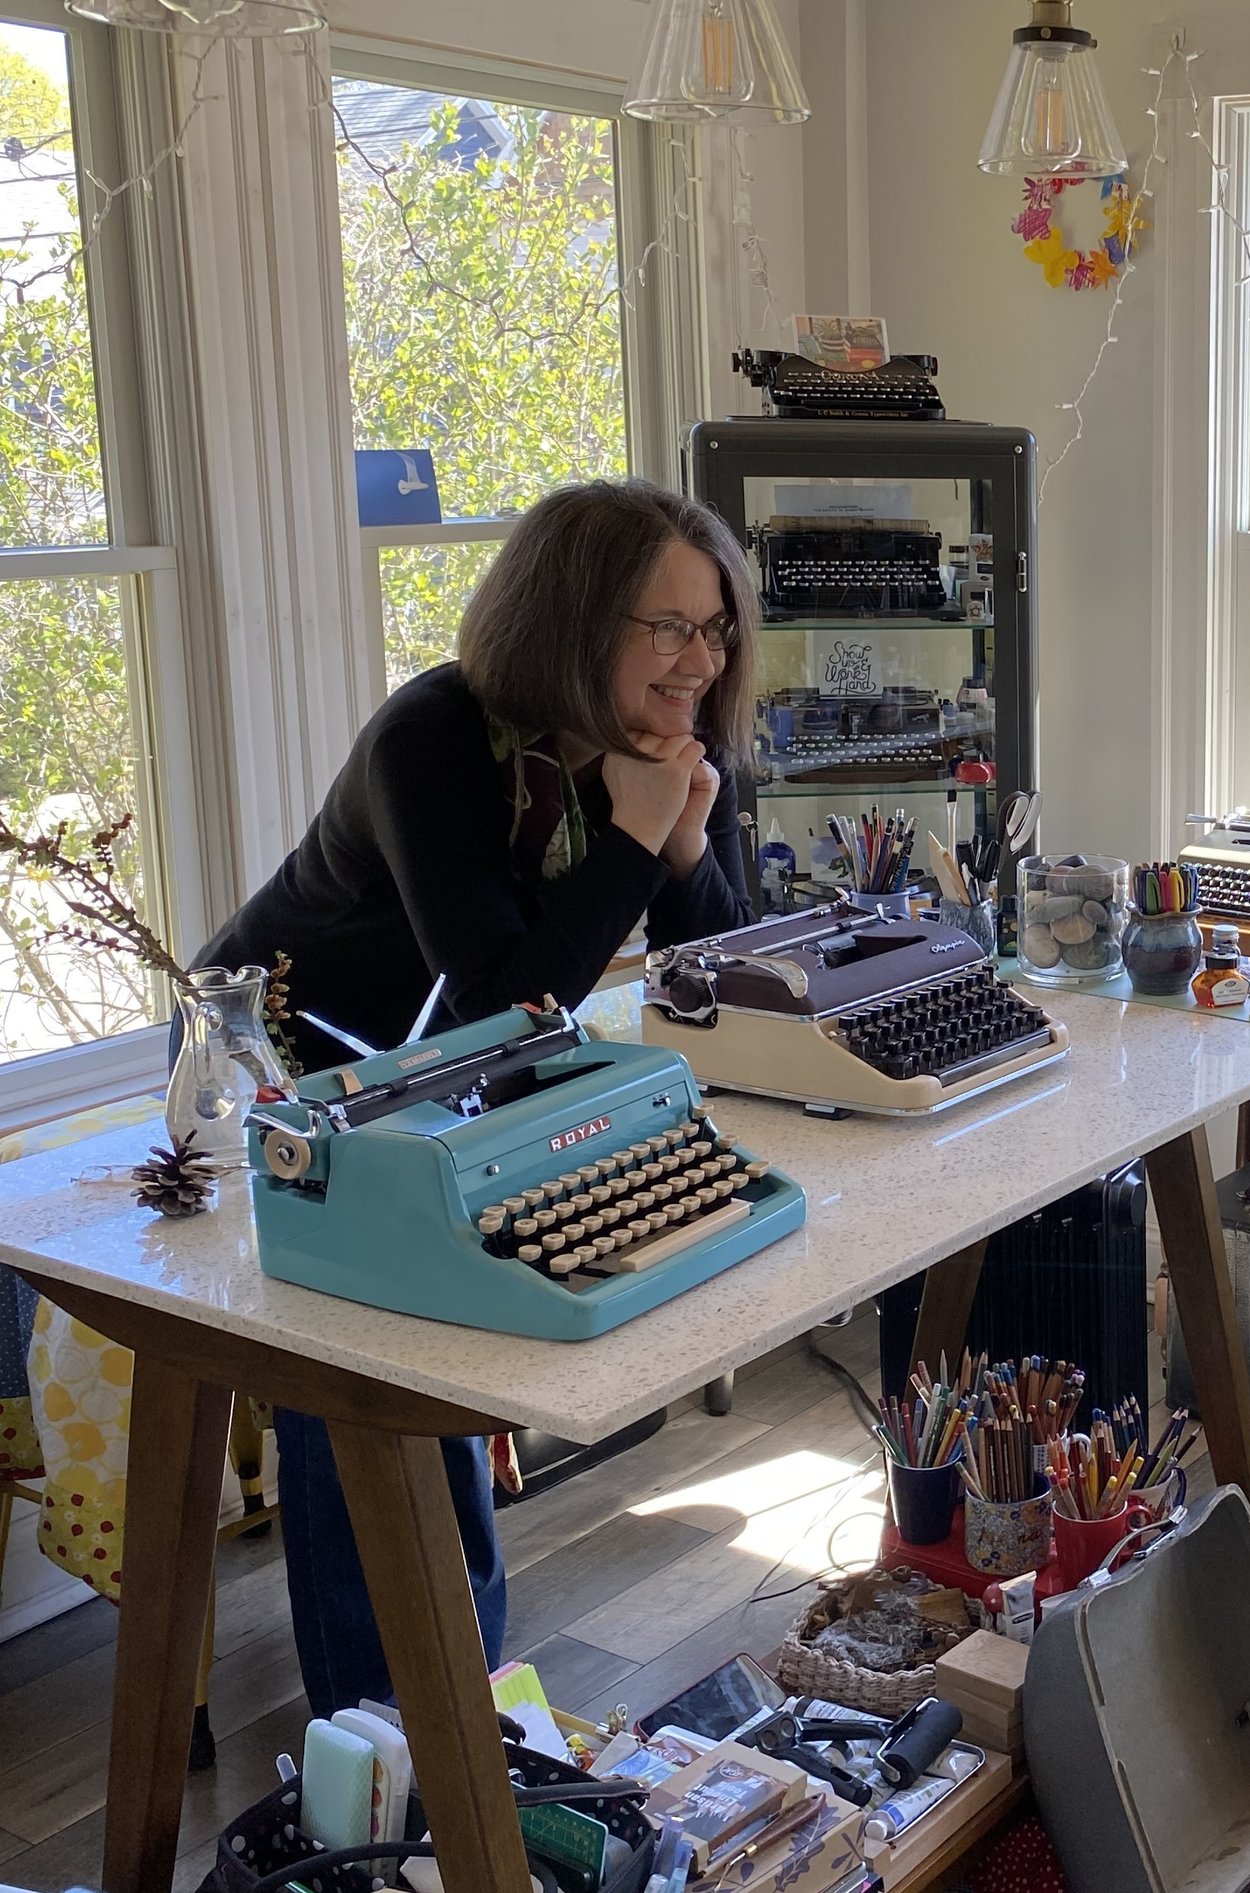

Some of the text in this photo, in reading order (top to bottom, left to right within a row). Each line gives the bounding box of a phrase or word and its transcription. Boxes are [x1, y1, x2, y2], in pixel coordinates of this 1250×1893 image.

[829, 641, 872, 664] Show
[825, 663, 868, 682] Work
[550, 1118, 611, 1152] ROYAL
